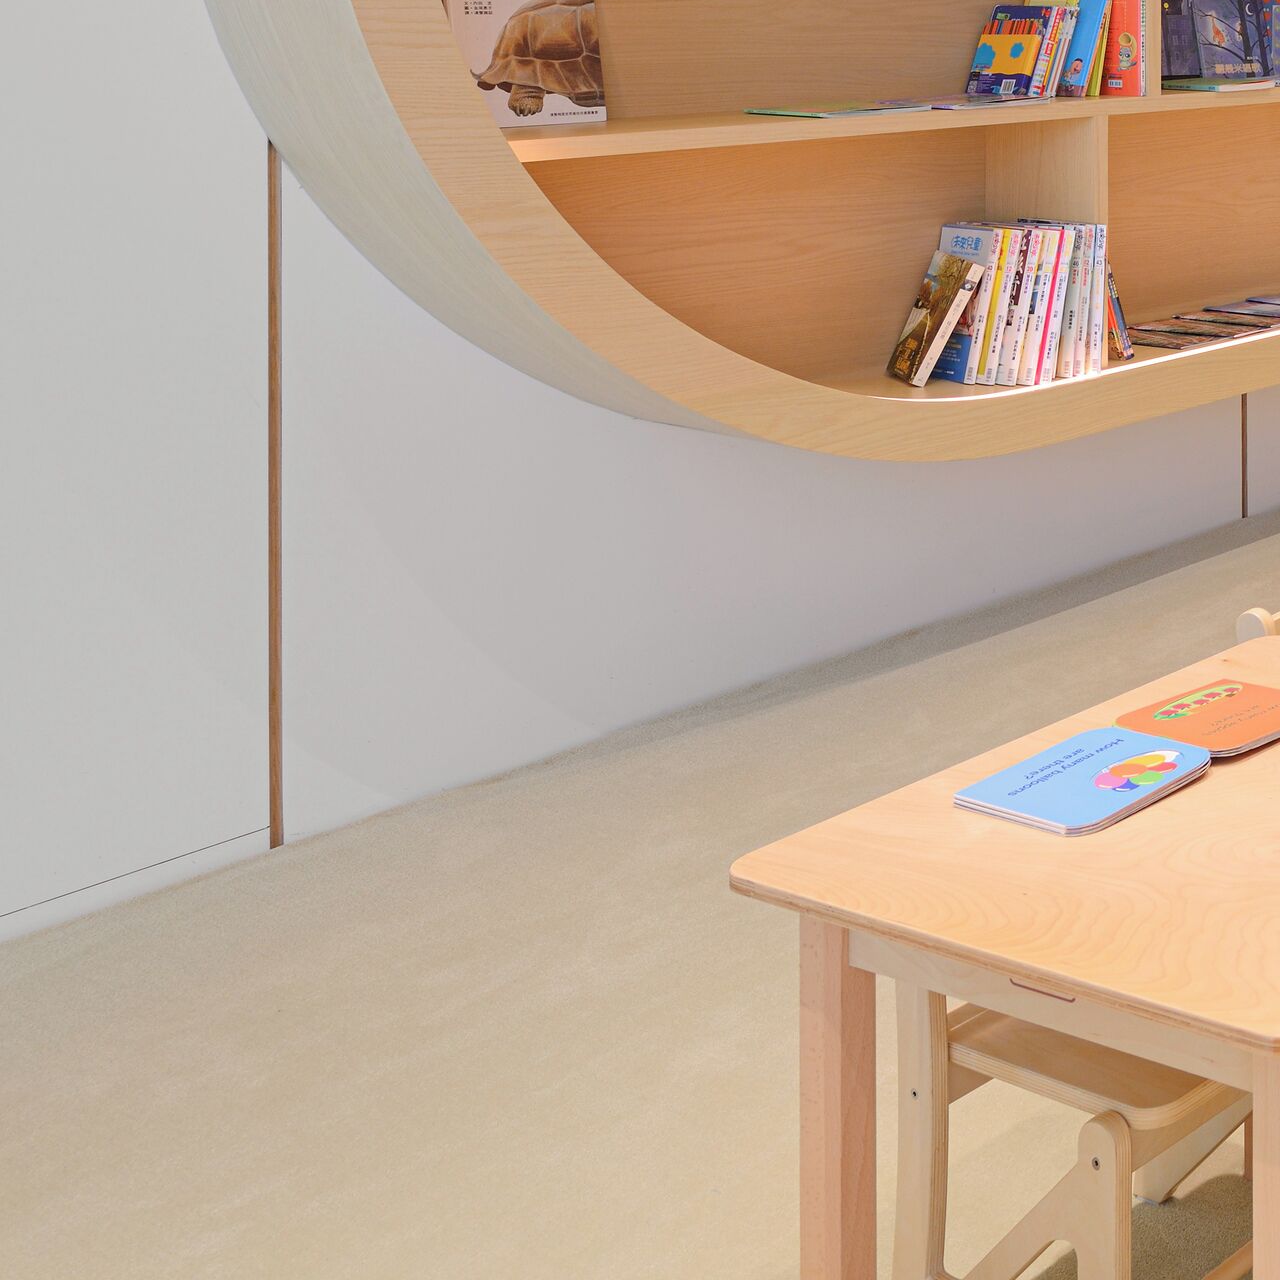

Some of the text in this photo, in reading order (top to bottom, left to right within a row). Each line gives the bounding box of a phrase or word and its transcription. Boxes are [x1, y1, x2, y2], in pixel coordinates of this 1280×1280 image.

[1007, 738, 1125, 797] How many balloons
[1024, 747, 1085, 781] are there?
